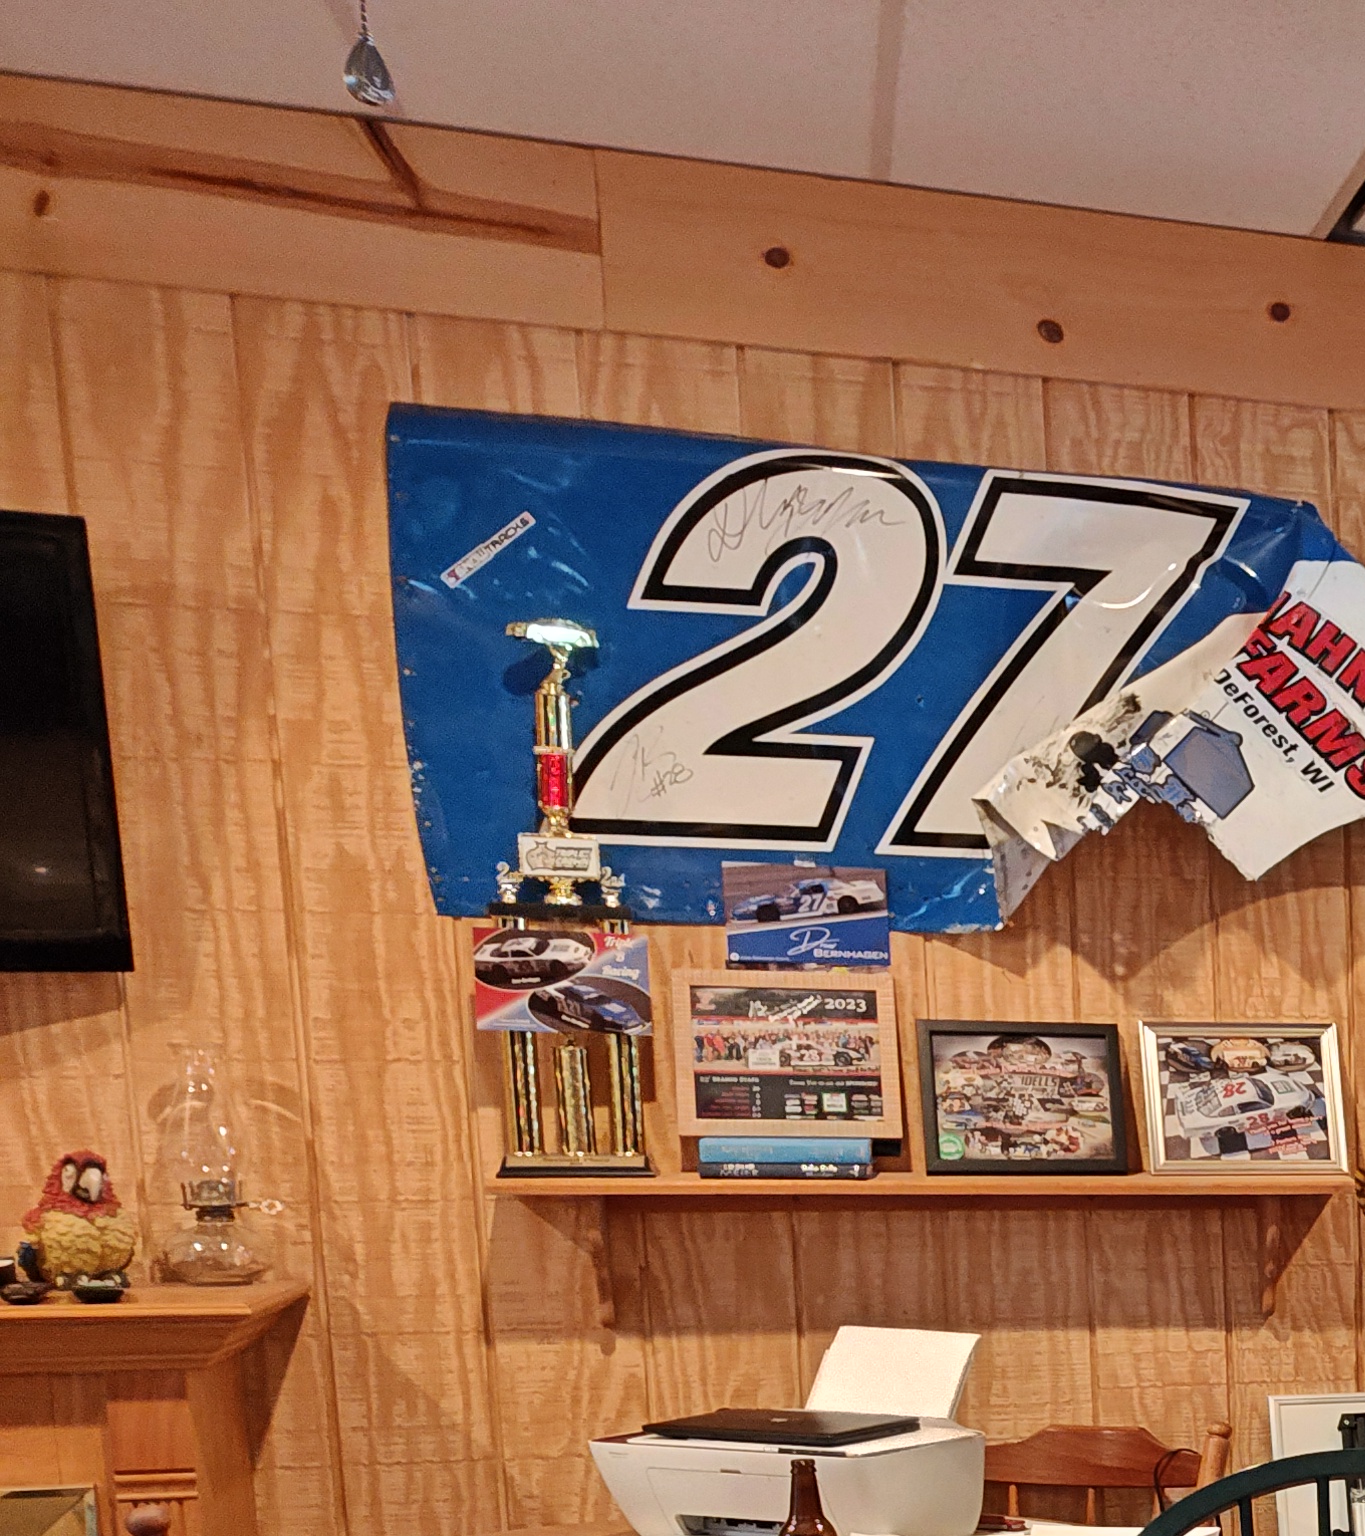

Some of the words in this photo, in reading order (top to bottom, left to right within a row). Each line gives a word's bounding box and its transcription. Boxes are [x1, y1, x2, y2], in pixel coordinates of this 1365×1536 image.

[565, 447, 1252, 858] 27
[1300, 760, 1335, 794] WI
[798, 894, 822, 913] 27
[824, 997, 867, 1013] 2023
